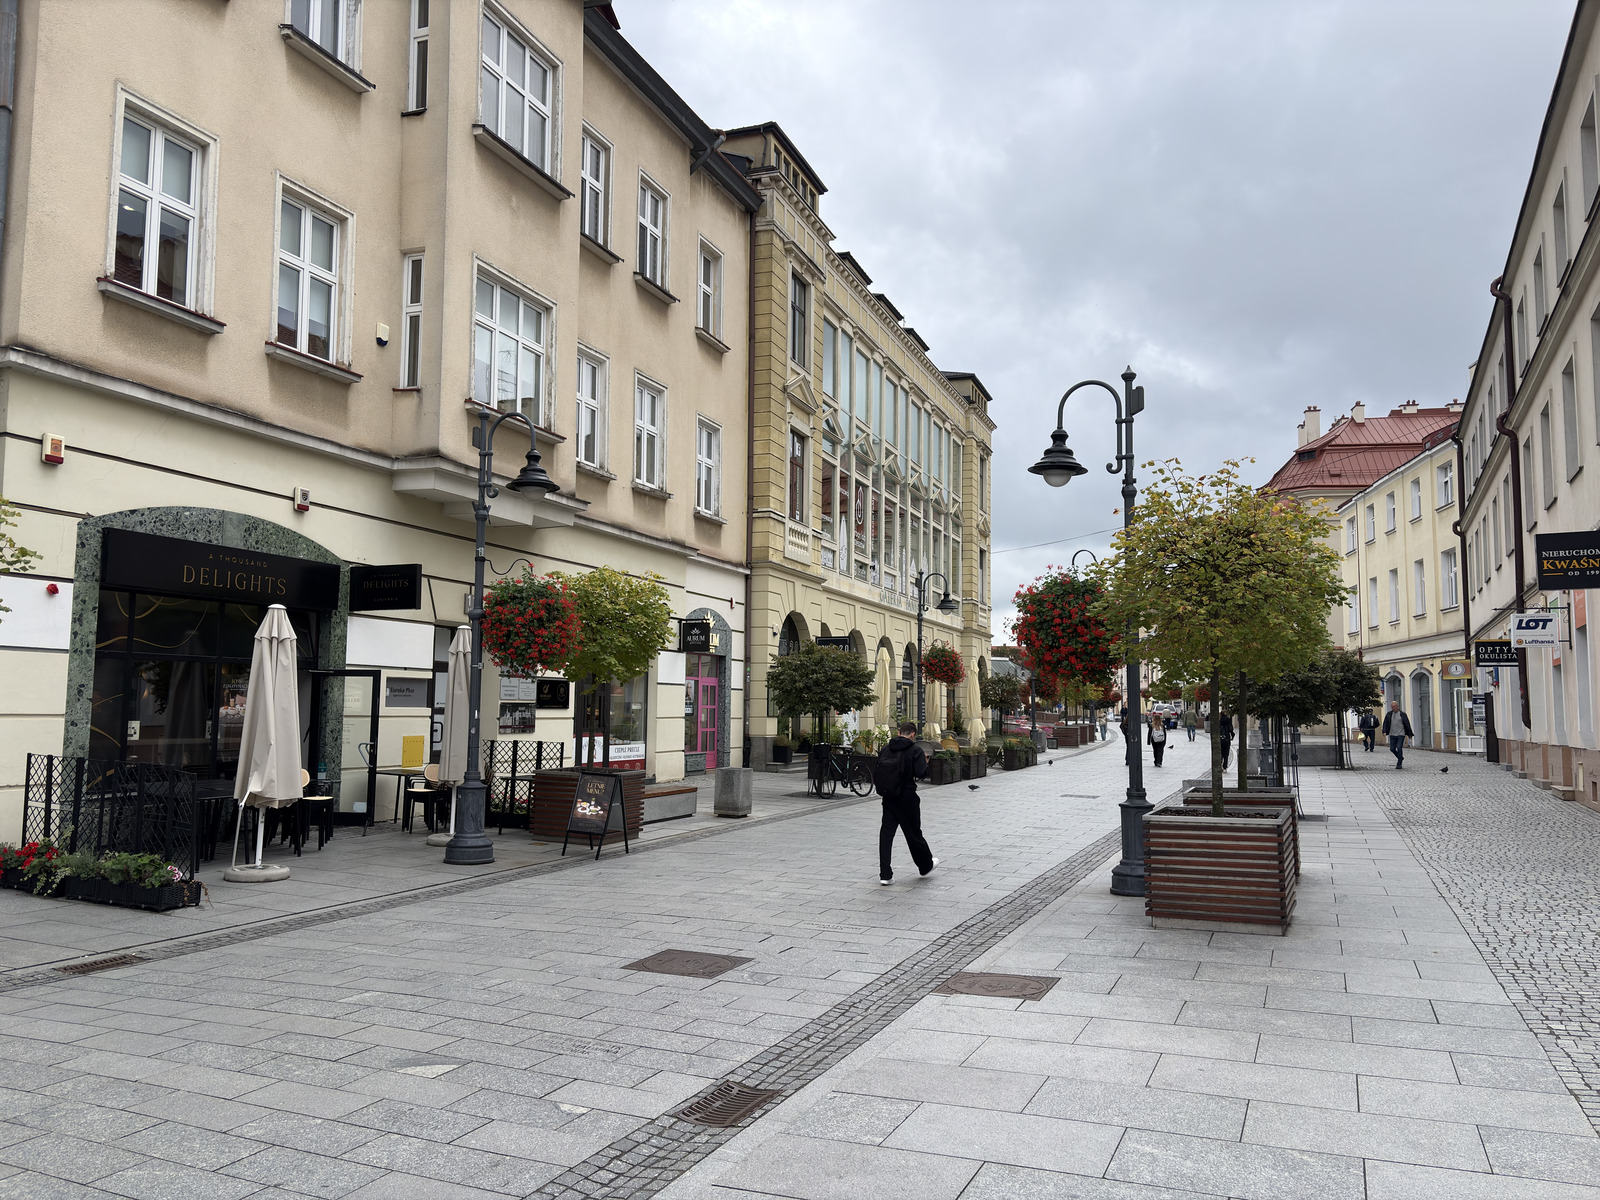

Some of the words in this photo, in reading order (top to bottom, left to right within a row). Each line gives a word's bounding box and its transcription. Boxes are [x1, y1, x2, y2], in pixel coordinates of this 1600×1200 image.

[219, 555, 268, 568] THOUSAND
[183, 565, 286, 595] DELIGHTS
[363, 579, 409, 589] DELIGHTS
[1516, 618, 1553, 630] LOT
